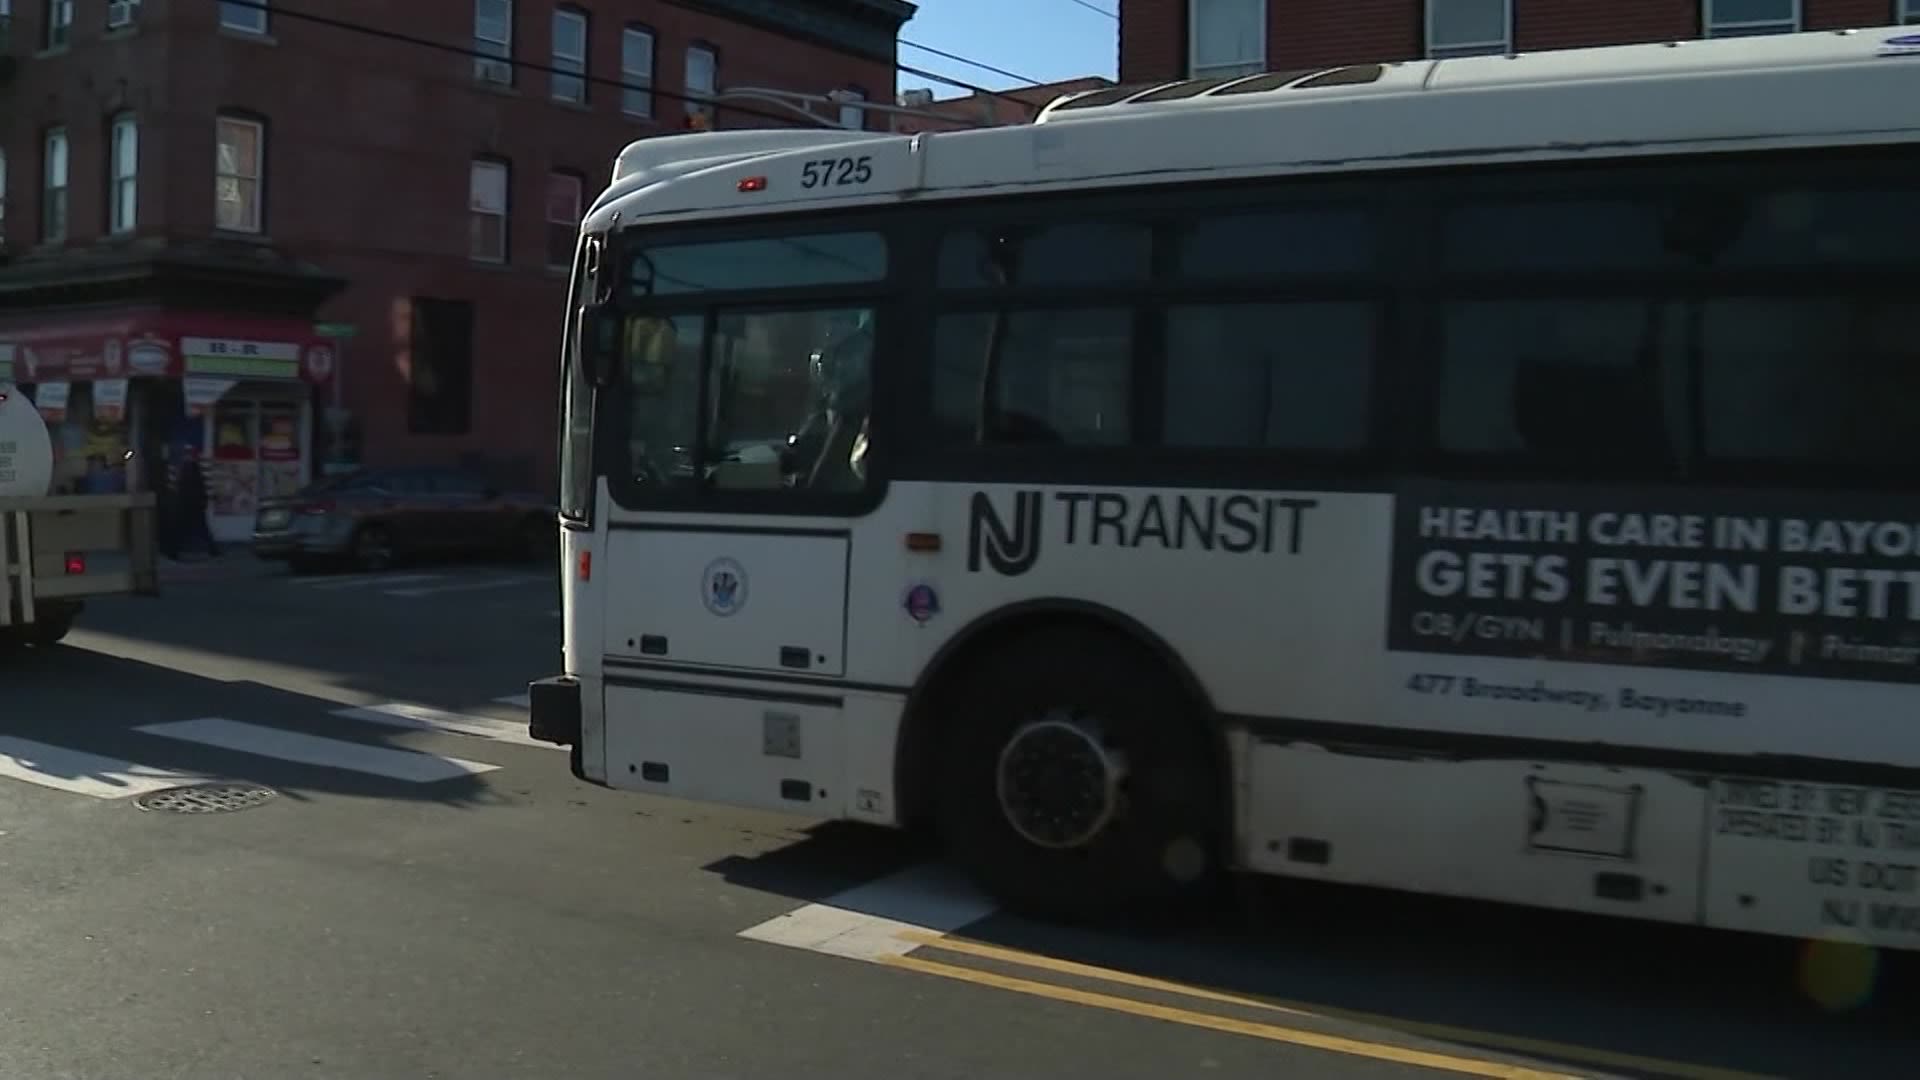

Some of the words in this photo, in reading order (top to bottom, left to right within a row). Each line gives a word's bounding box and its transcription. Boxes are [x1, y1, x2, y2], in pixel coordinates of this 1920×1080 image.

[801, 156, 873, 190] 5725
[967, 490, 1043, 576] NJ
[1055, 491, 1319, 555] TRANSIT
[1419, 507, 1578, 544] HEALTH
[1588, 513, 1705, 549] CARE
[1714, 516, 1769, 551] IN
[1416, 550, 1570, 602] GETS
[1586, 557, 1760, 612] EVEN
[1412, 611, 1545, 642] OB/GYN
[1590, 621, 1774, 662] Pulmonology
[1407, 674, 1453, 696] 477
[1620, 688, 1747, 717] Bayonne
